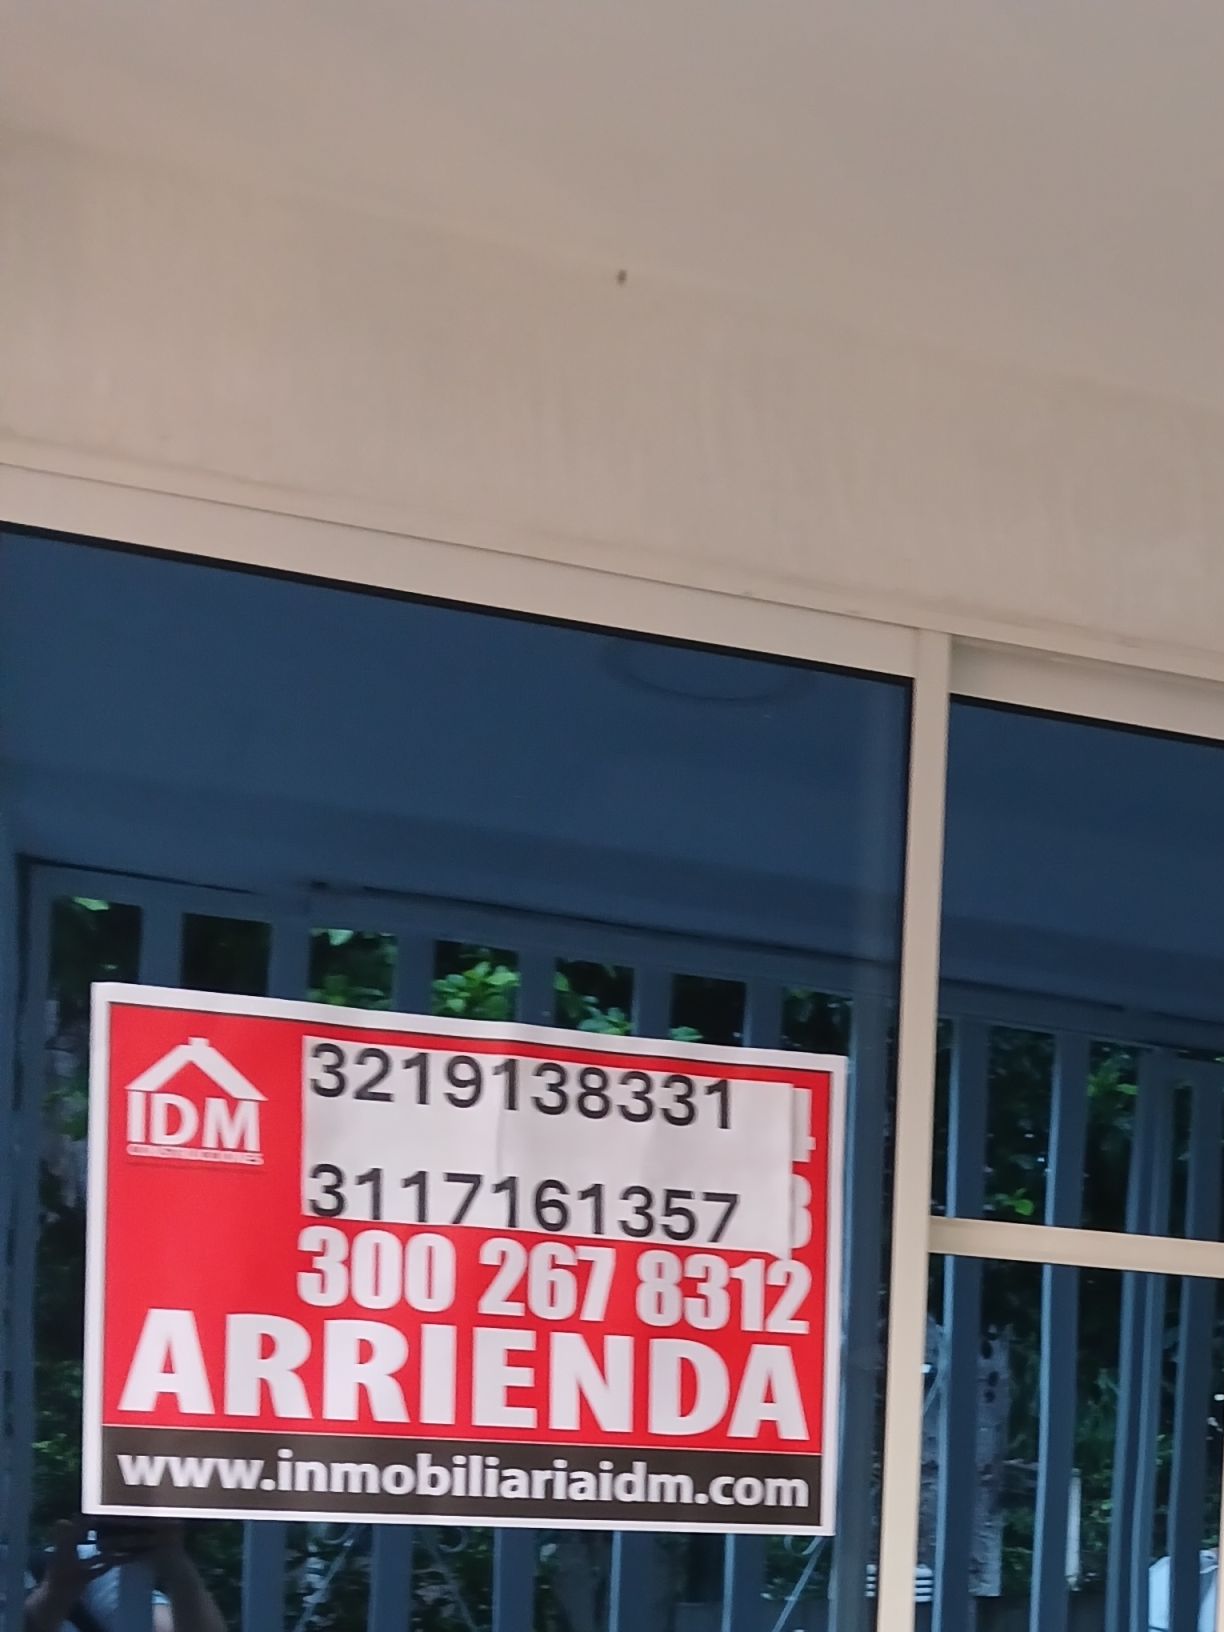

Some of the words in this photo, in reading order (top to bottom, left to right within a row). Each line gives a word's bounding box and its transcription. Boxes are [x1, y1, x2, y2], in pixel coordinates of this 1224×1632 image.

[127, 1090, 261, 1152] IDM
[309, 1043, 732, 1130] 3219138331
[309, 1164, 739, 1244] 3117161357
[297, 1225, 455, 1312] 300
[478, 1238, 616, 1323] 267
[636, 1250, 811, 1335] 8312
[118, 1308, 810, 1440] ARRIENDA
[117, 1448, 810, 1508] www.inmobiliariaidm.com
